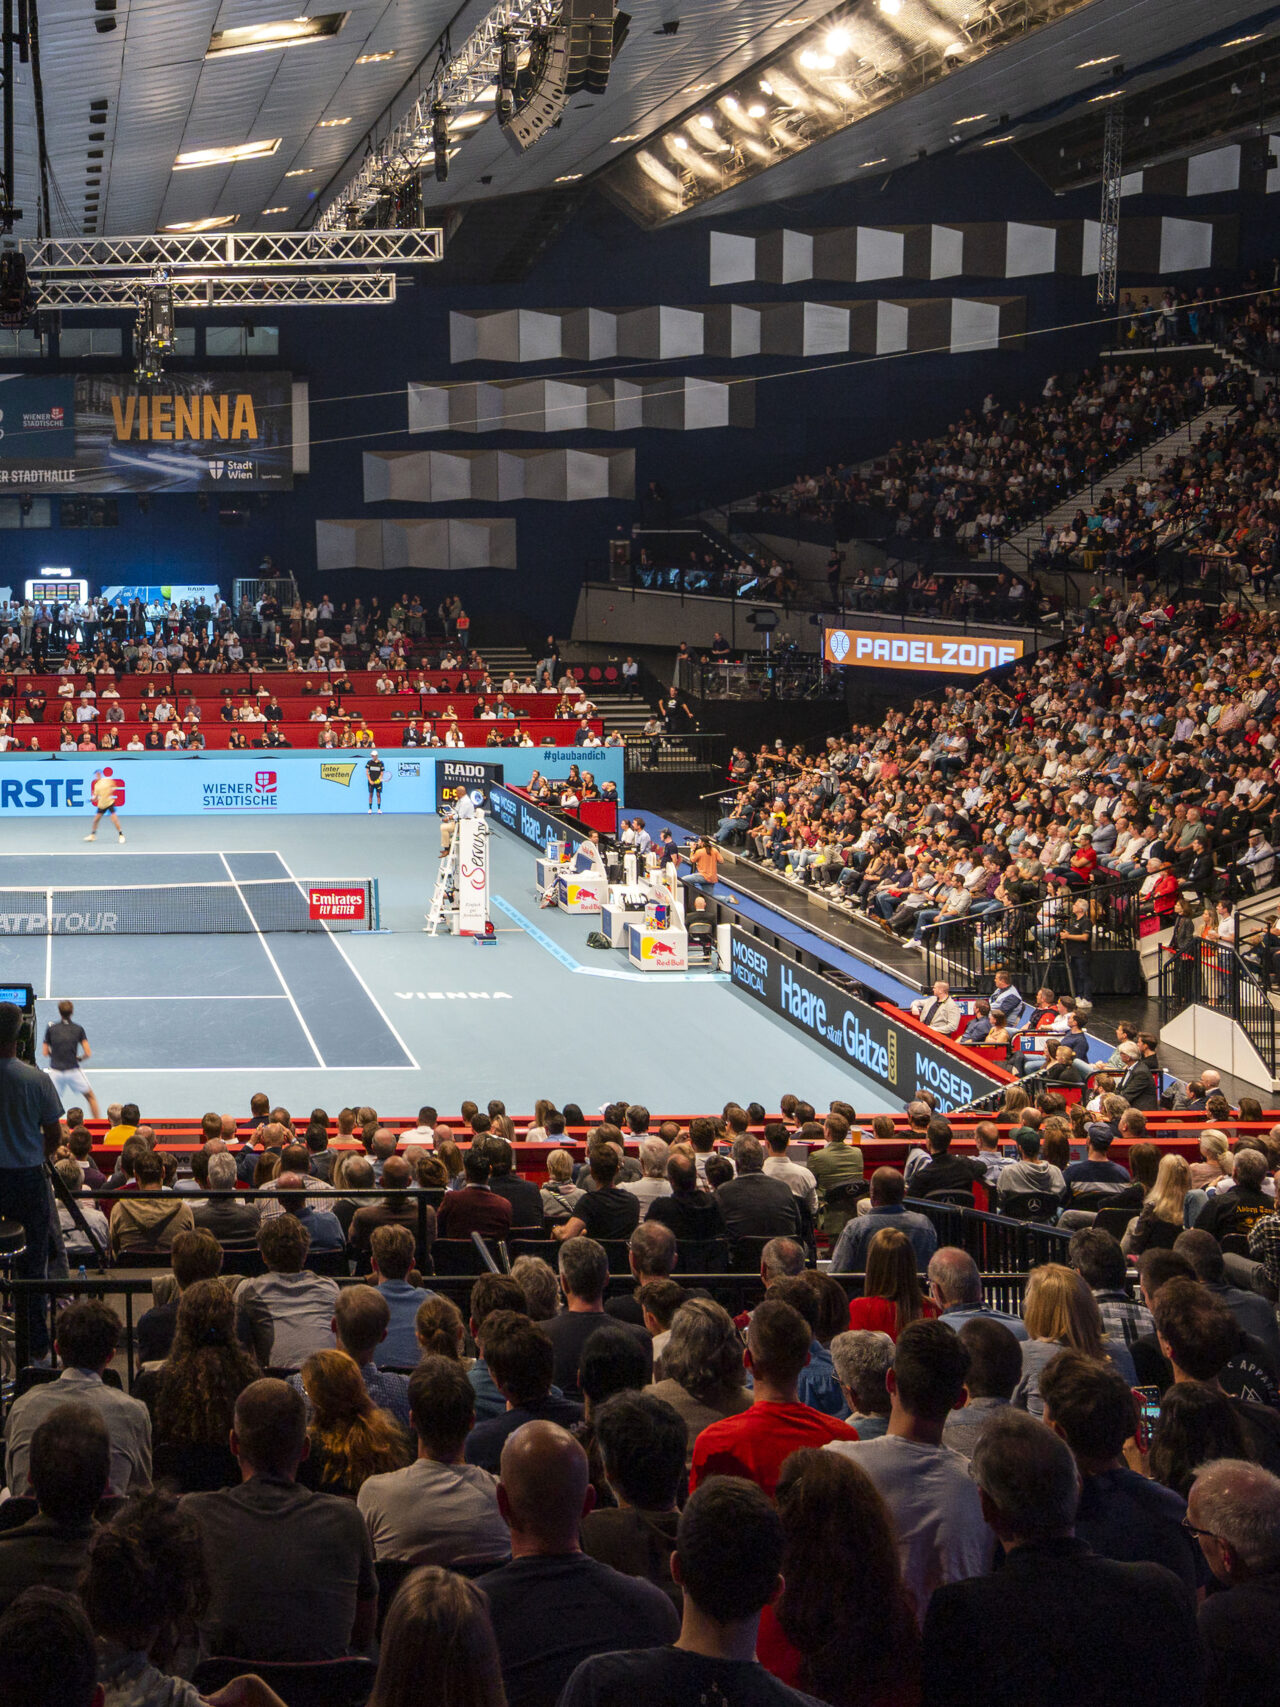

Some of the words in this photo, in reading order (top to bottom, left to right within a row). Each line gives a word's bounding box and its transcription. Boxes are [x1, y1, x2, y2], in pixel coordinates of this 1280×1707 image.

[111, 394, 258, 440] VIENNA
[227, 460, 253, 470] Stadt
[11, 469, 76, 483] STADTHALLE
[227, 470, 253, 480] Wien
[856, 637, 1016, 668] PADELZONE
[544, 750, 606, 762] #glaubandich
[323, 764, 339, 772] inter
[444, 763, 485, 777] RADO
[203, 783, 253, 794] WIENER
[311, 893, 362, 905] Emirates
[320, 905, 331, 915] FLY
[331, 905, 355, 915] BETTER
[50, 912, 118, 932] TOUR
[732, 937, 768, 978] MOSER
[732, 961, 766, 997] MEDICAL
[393, 991, 513, 1000] VIENNA
[780, 964, 827, 1036] Haare
[842, 1010, 889, 1078] Glatze
[1024, 1042, 1032, 1050] 17
[915, 1051, 973, 1104] MOSER
